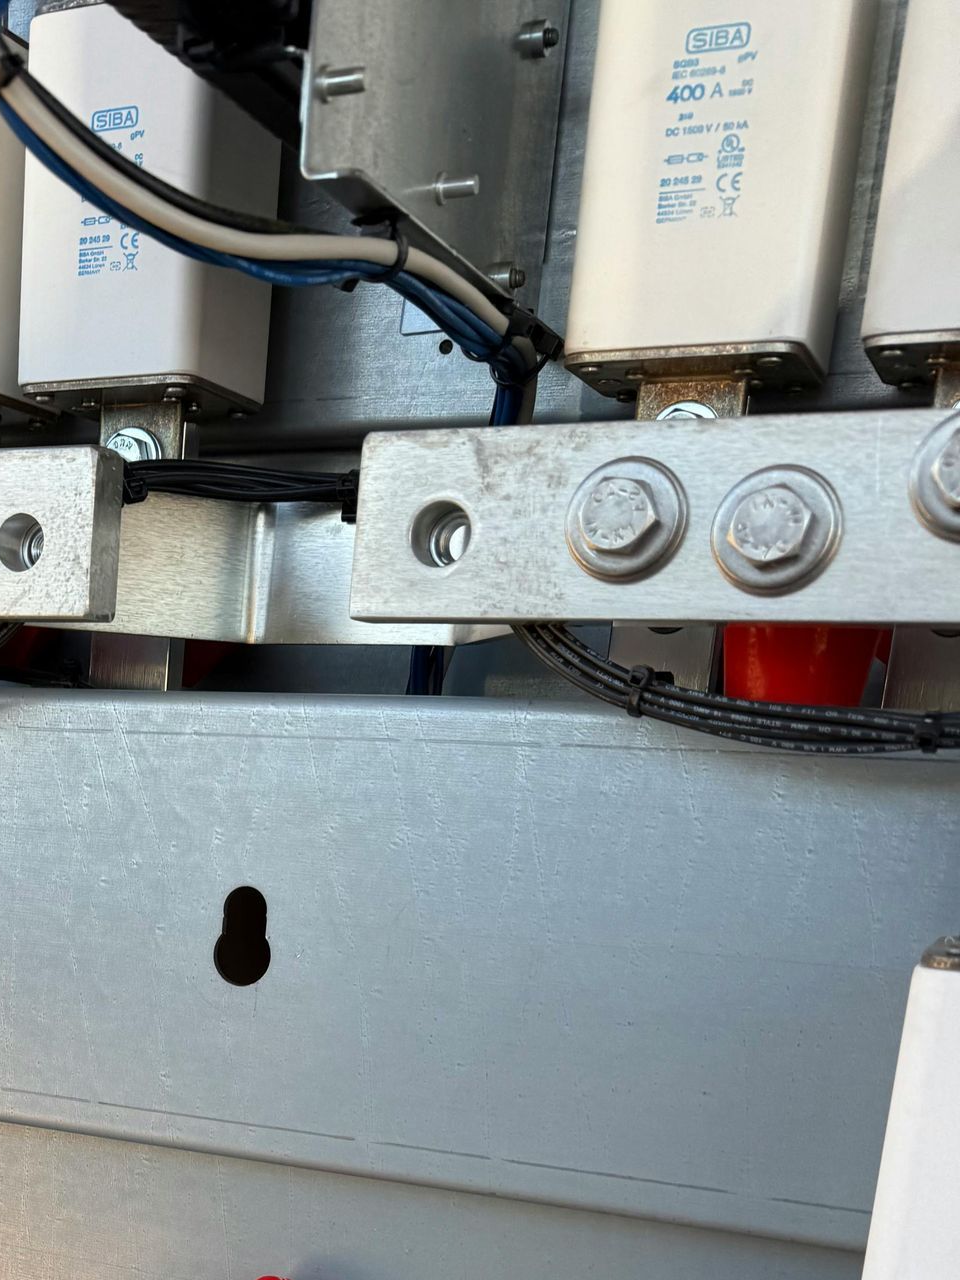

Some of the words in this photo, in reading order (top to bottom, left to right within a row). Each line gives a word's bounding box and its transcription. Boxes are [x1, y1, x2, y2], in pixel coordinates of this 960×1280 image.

[692, 28, 745, 49] SIBA
[666, 83, 705, 104] 400
[710, 82, 724, 99] A
[96, 110, 134, 128] SIBA
[665, 127, 680, 137] DC
[706, 123, 713, 133] V
